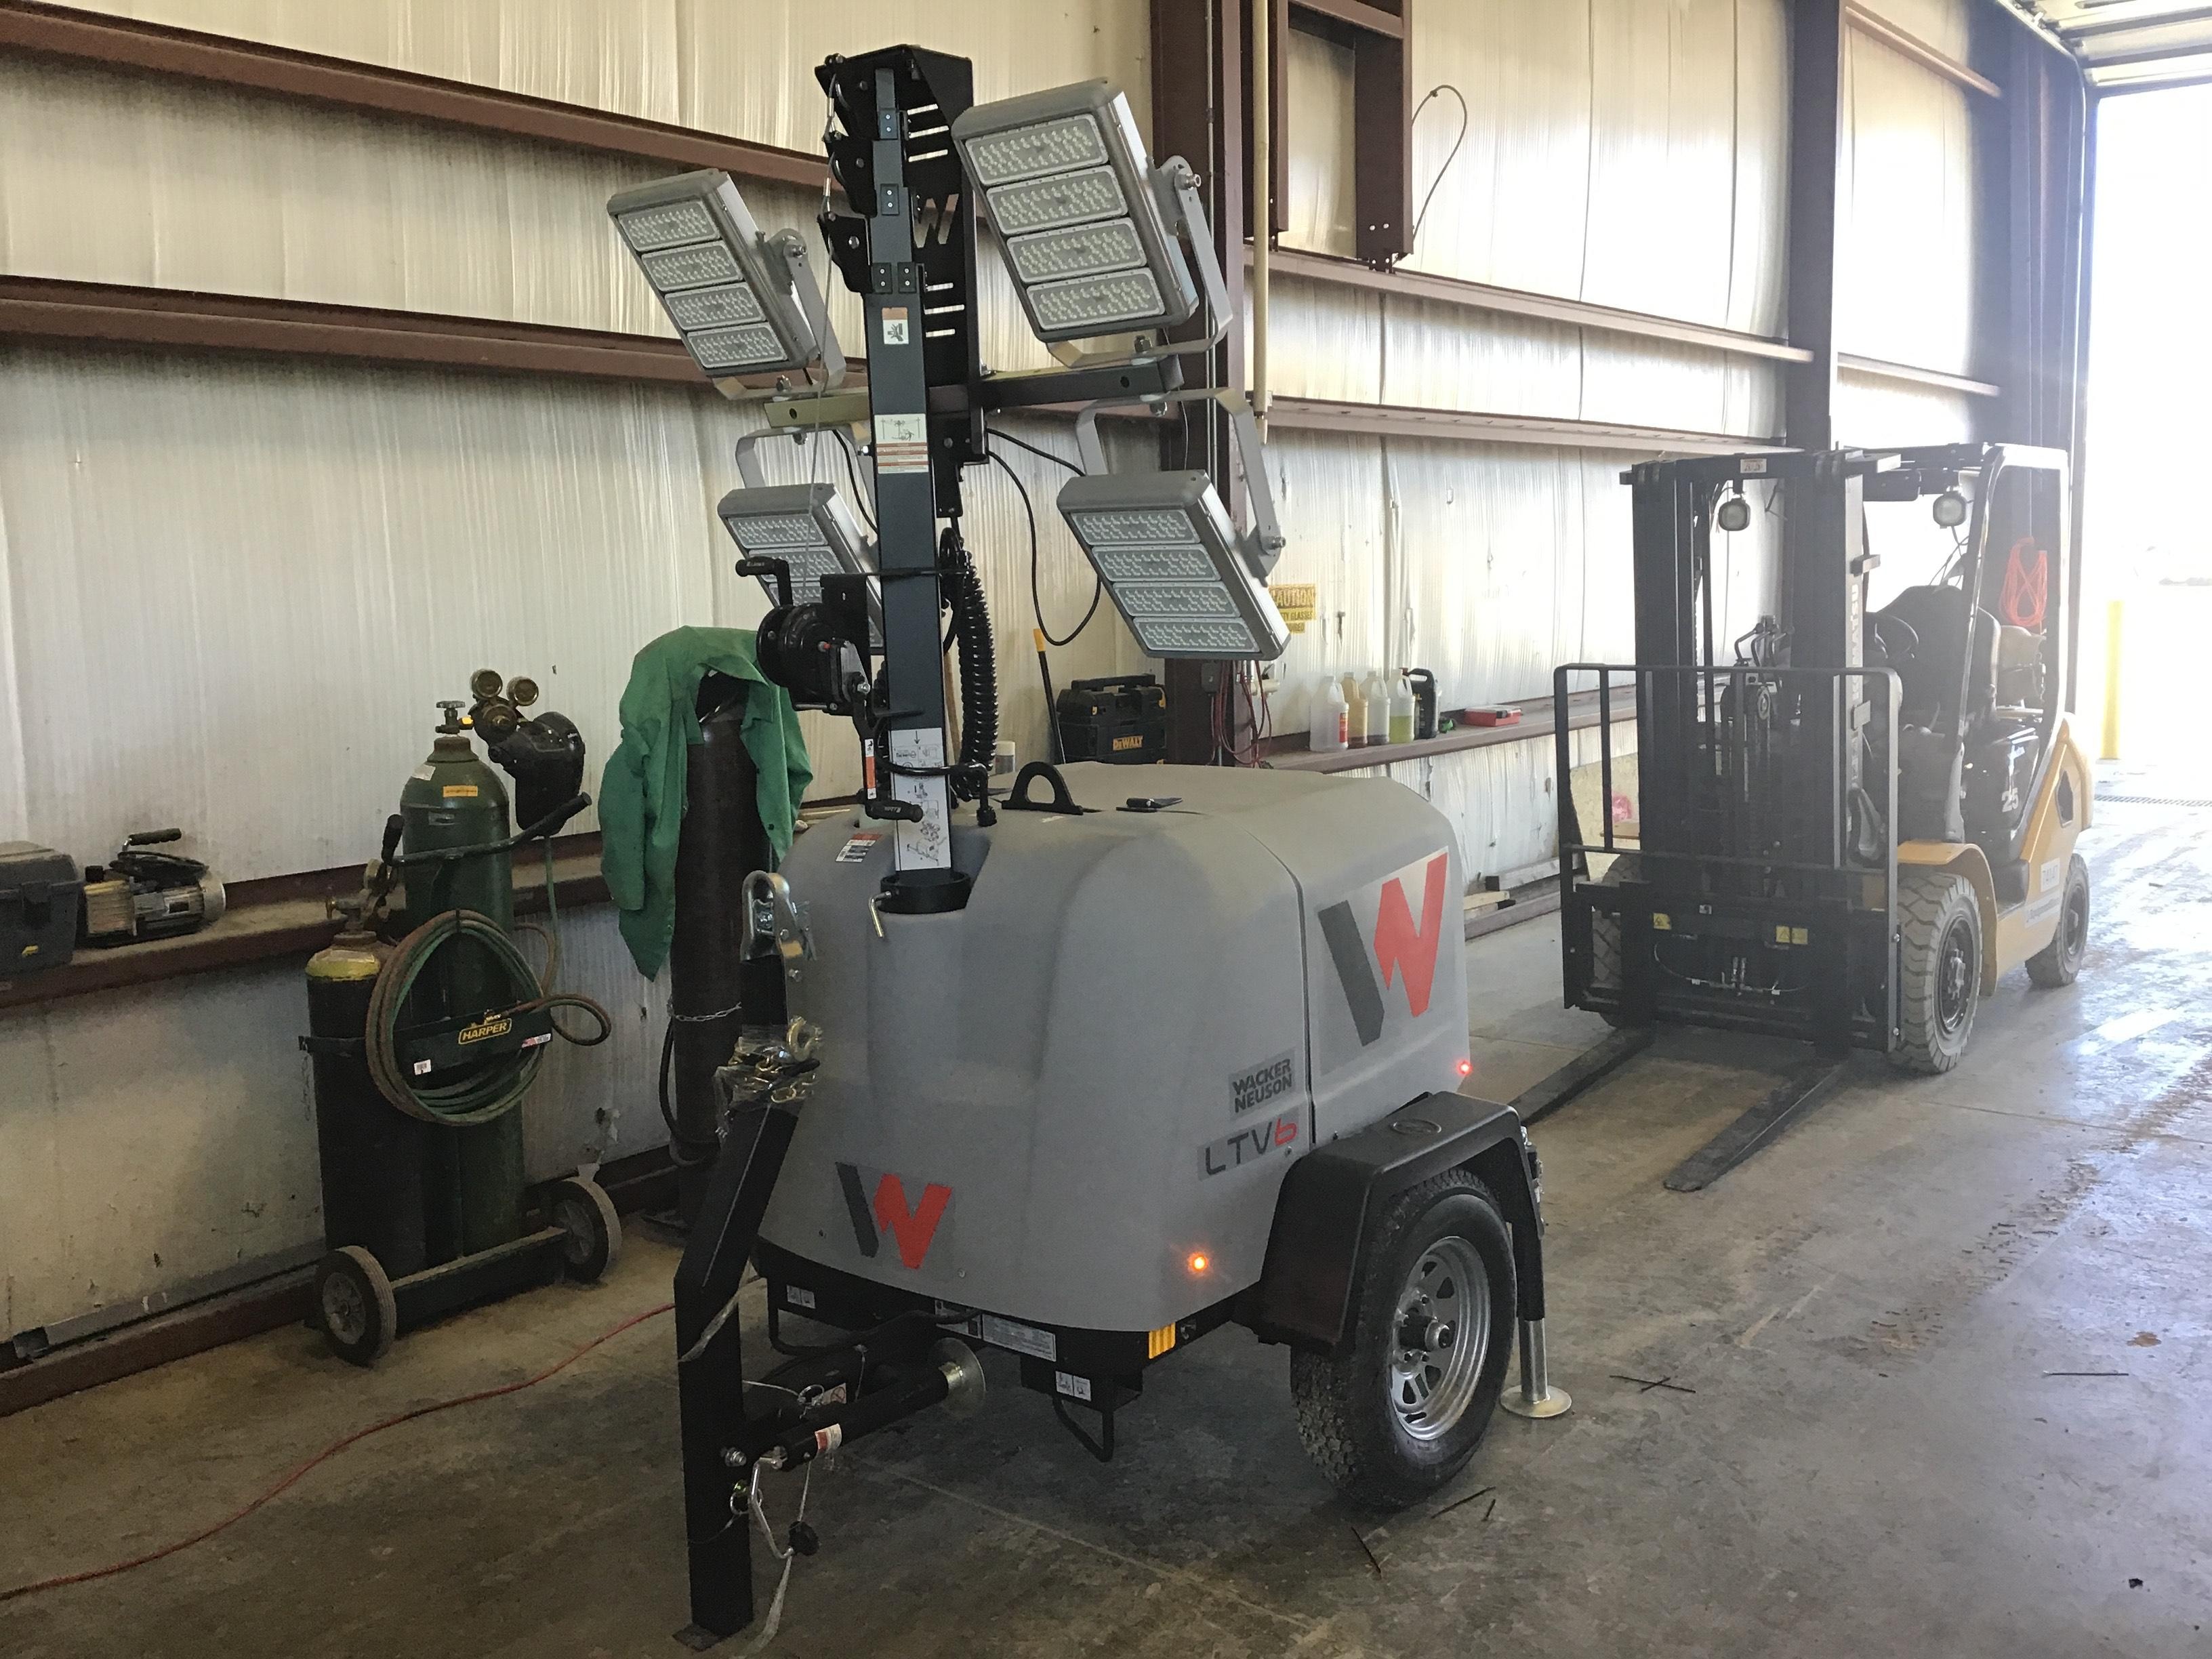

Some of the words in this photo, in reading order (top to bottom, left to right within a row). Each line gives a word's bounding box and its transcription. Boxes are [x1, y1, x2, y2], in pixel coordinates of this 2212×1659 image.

[2001, 787, 2019, 812] 25
[462, 1022, 507, 1041] HARPER
[1232, 1059, 1291, 1095] WACKER
[1234, 1073, 1292, 1113] NEUSON
